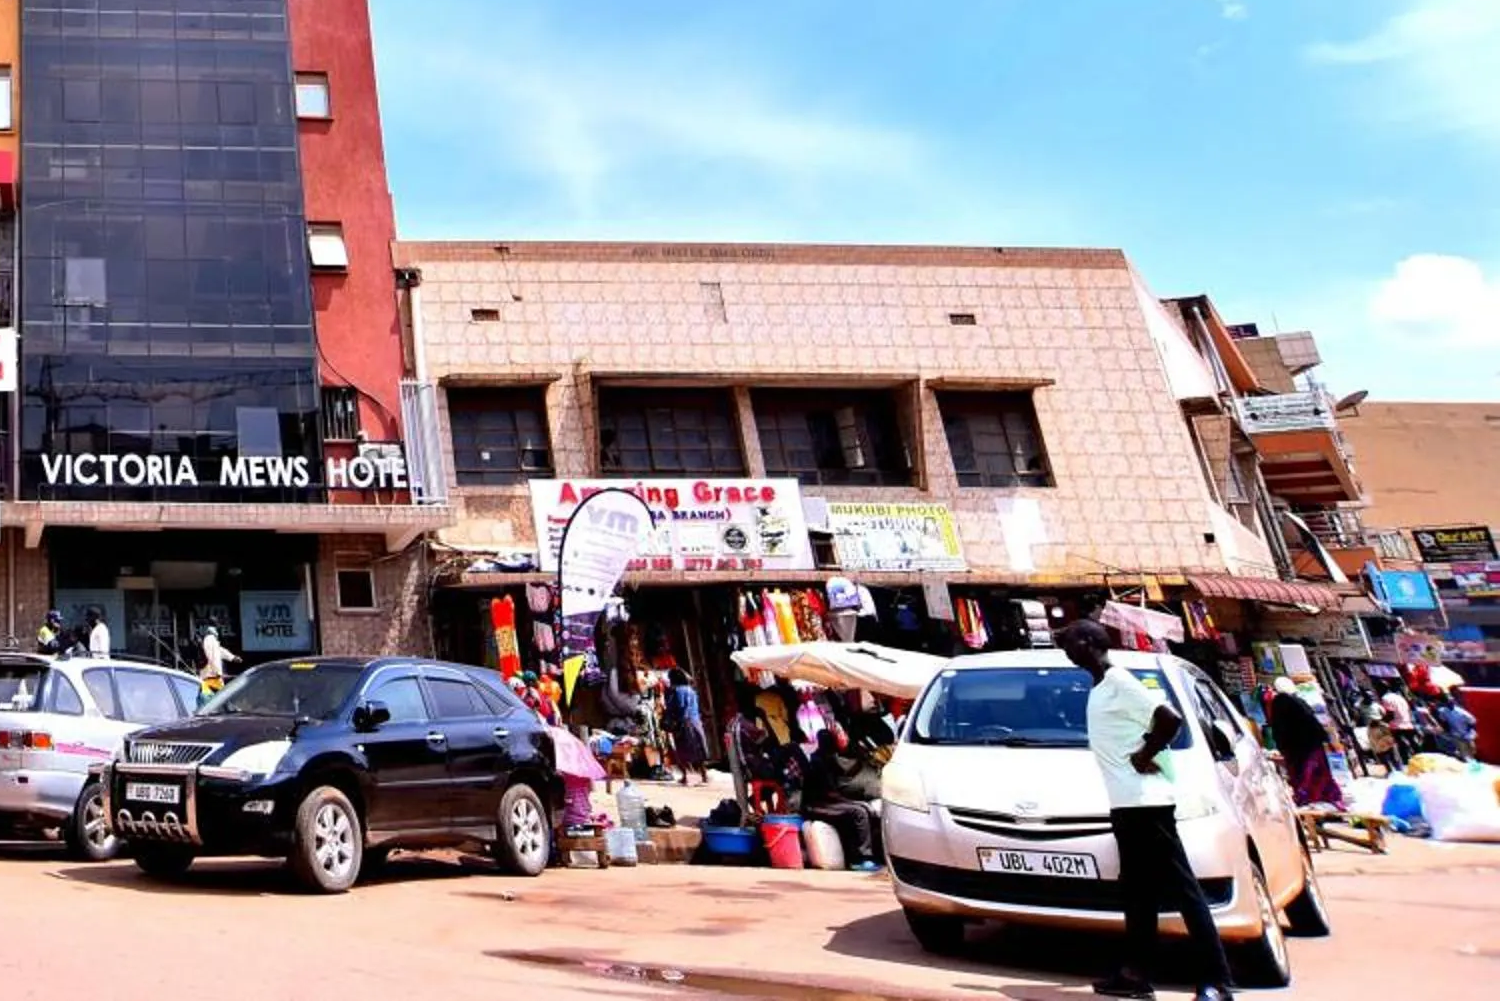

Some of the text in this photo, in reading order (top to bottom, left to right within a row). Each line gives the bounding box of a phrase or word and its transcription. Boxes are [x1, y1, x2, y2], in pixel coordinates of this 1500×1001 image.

[41, 453, 199, 486] VICTORIA
[219, 455, 309, 487] MEWS
[692, 481, 776, 504] Grace
[895, 505, 947, 517] PHOTO
[256, 626, 297, 638] HOTEL
[999, 852, 1088, 875] UBL 402M
